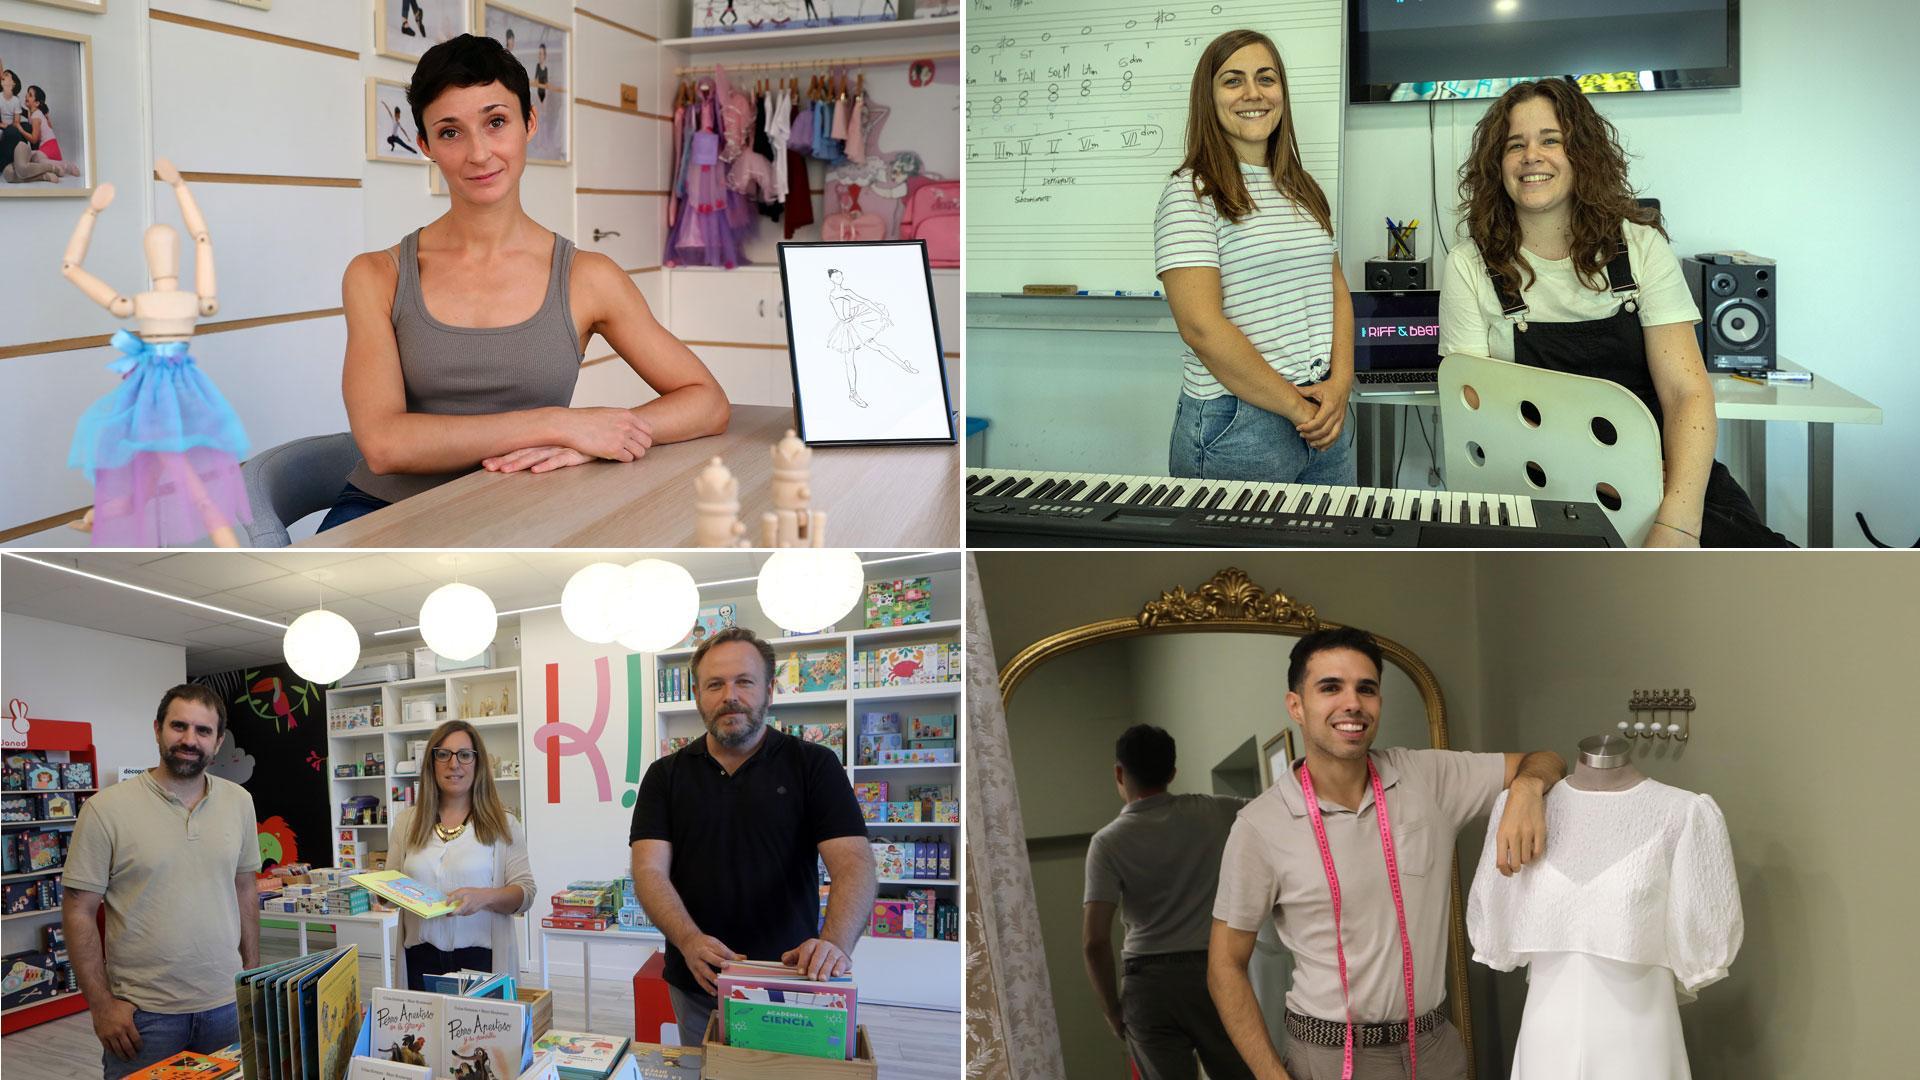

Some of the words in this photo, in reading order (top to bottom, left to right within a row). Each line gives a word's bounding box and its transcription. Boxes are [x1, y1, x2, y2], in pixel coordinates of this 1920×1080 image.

[1397, 326, 1408, 337] &
[761, 1015, 814, 1028] CIENCIA
[448, 1018, 471, 1040] Perro
